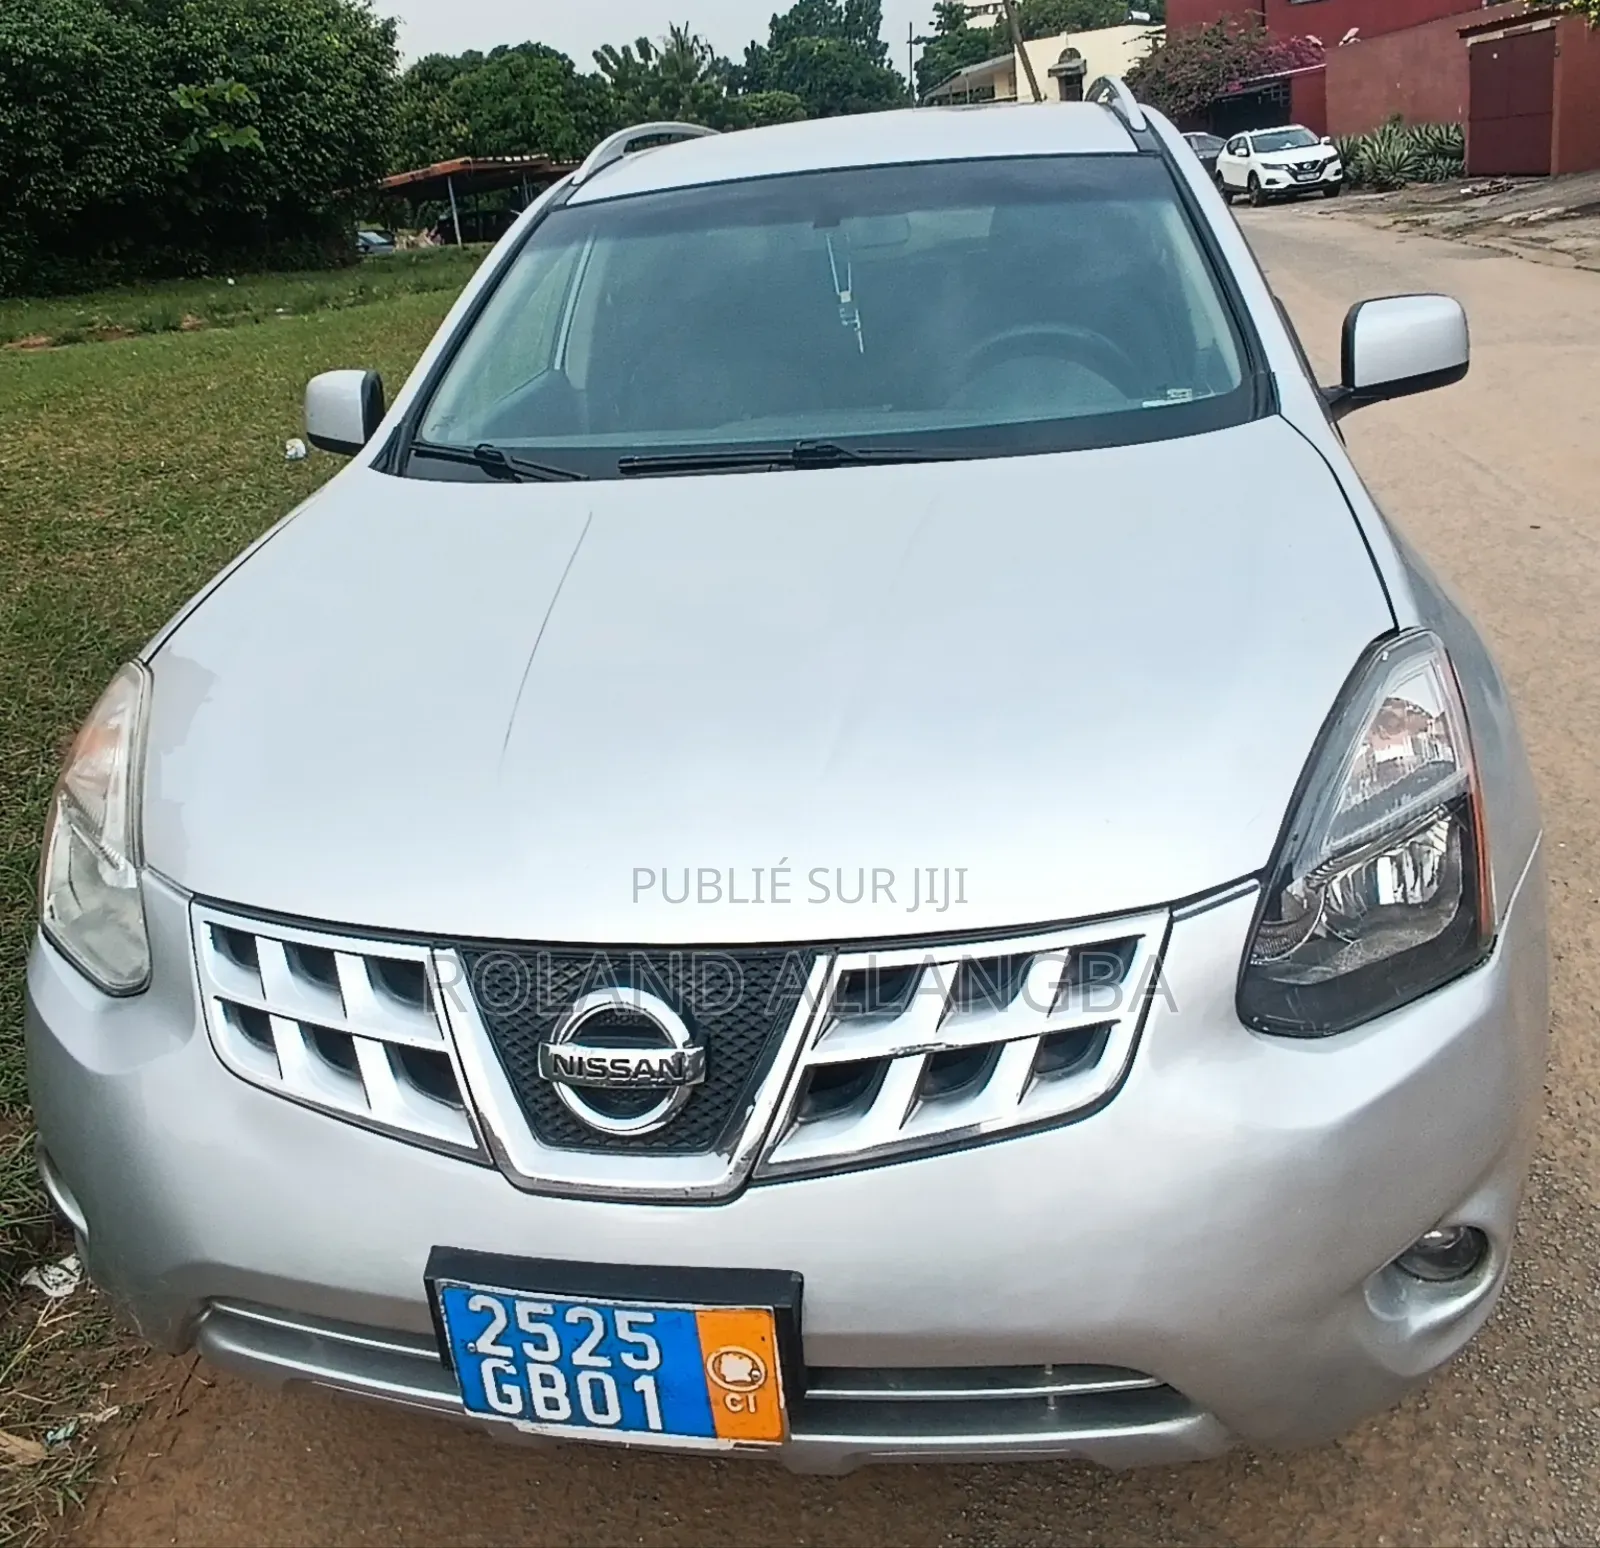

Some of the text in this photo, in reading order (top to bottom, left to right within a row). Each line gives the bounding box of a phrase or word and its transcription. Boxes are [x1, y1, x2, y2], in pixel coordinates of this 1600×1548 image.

[553, 1052, 685, 1081] NISSAN
[467, 1294, 663, 1371] 2525
[480, 1360, 664, 1431] GB01
[724, 1392, 757, 1414] CI
